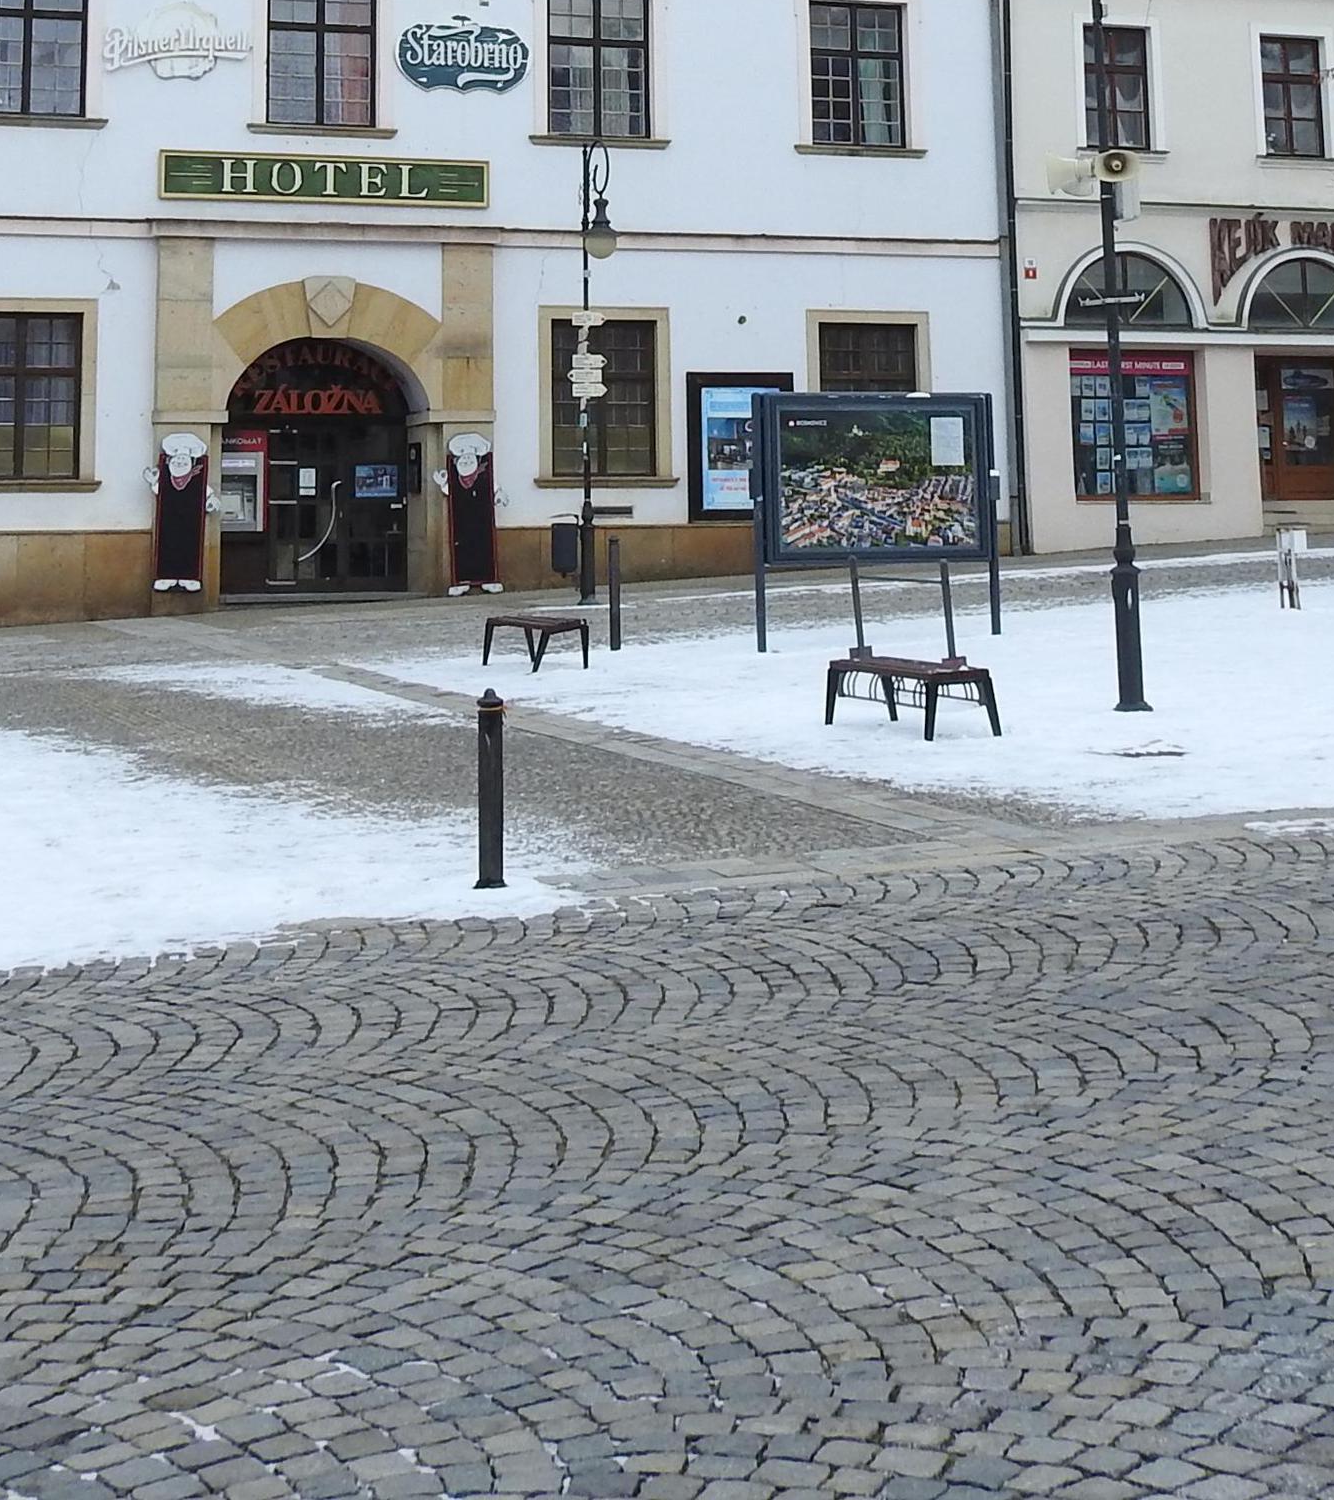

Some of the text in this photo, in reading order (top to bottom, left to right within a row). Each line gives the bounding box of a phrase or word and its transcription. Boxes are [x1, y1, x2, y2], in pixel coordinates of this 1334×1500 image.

[102, 27, 252, 70] Pilsner Urquell
[405, 23, 523, 70] Starobrno
[220, 158, 429, 198] HOTEL
[1209, 212, 1281, 306] KEJÍK
[253, 383, 384, 414] ZÁLOŽNA
